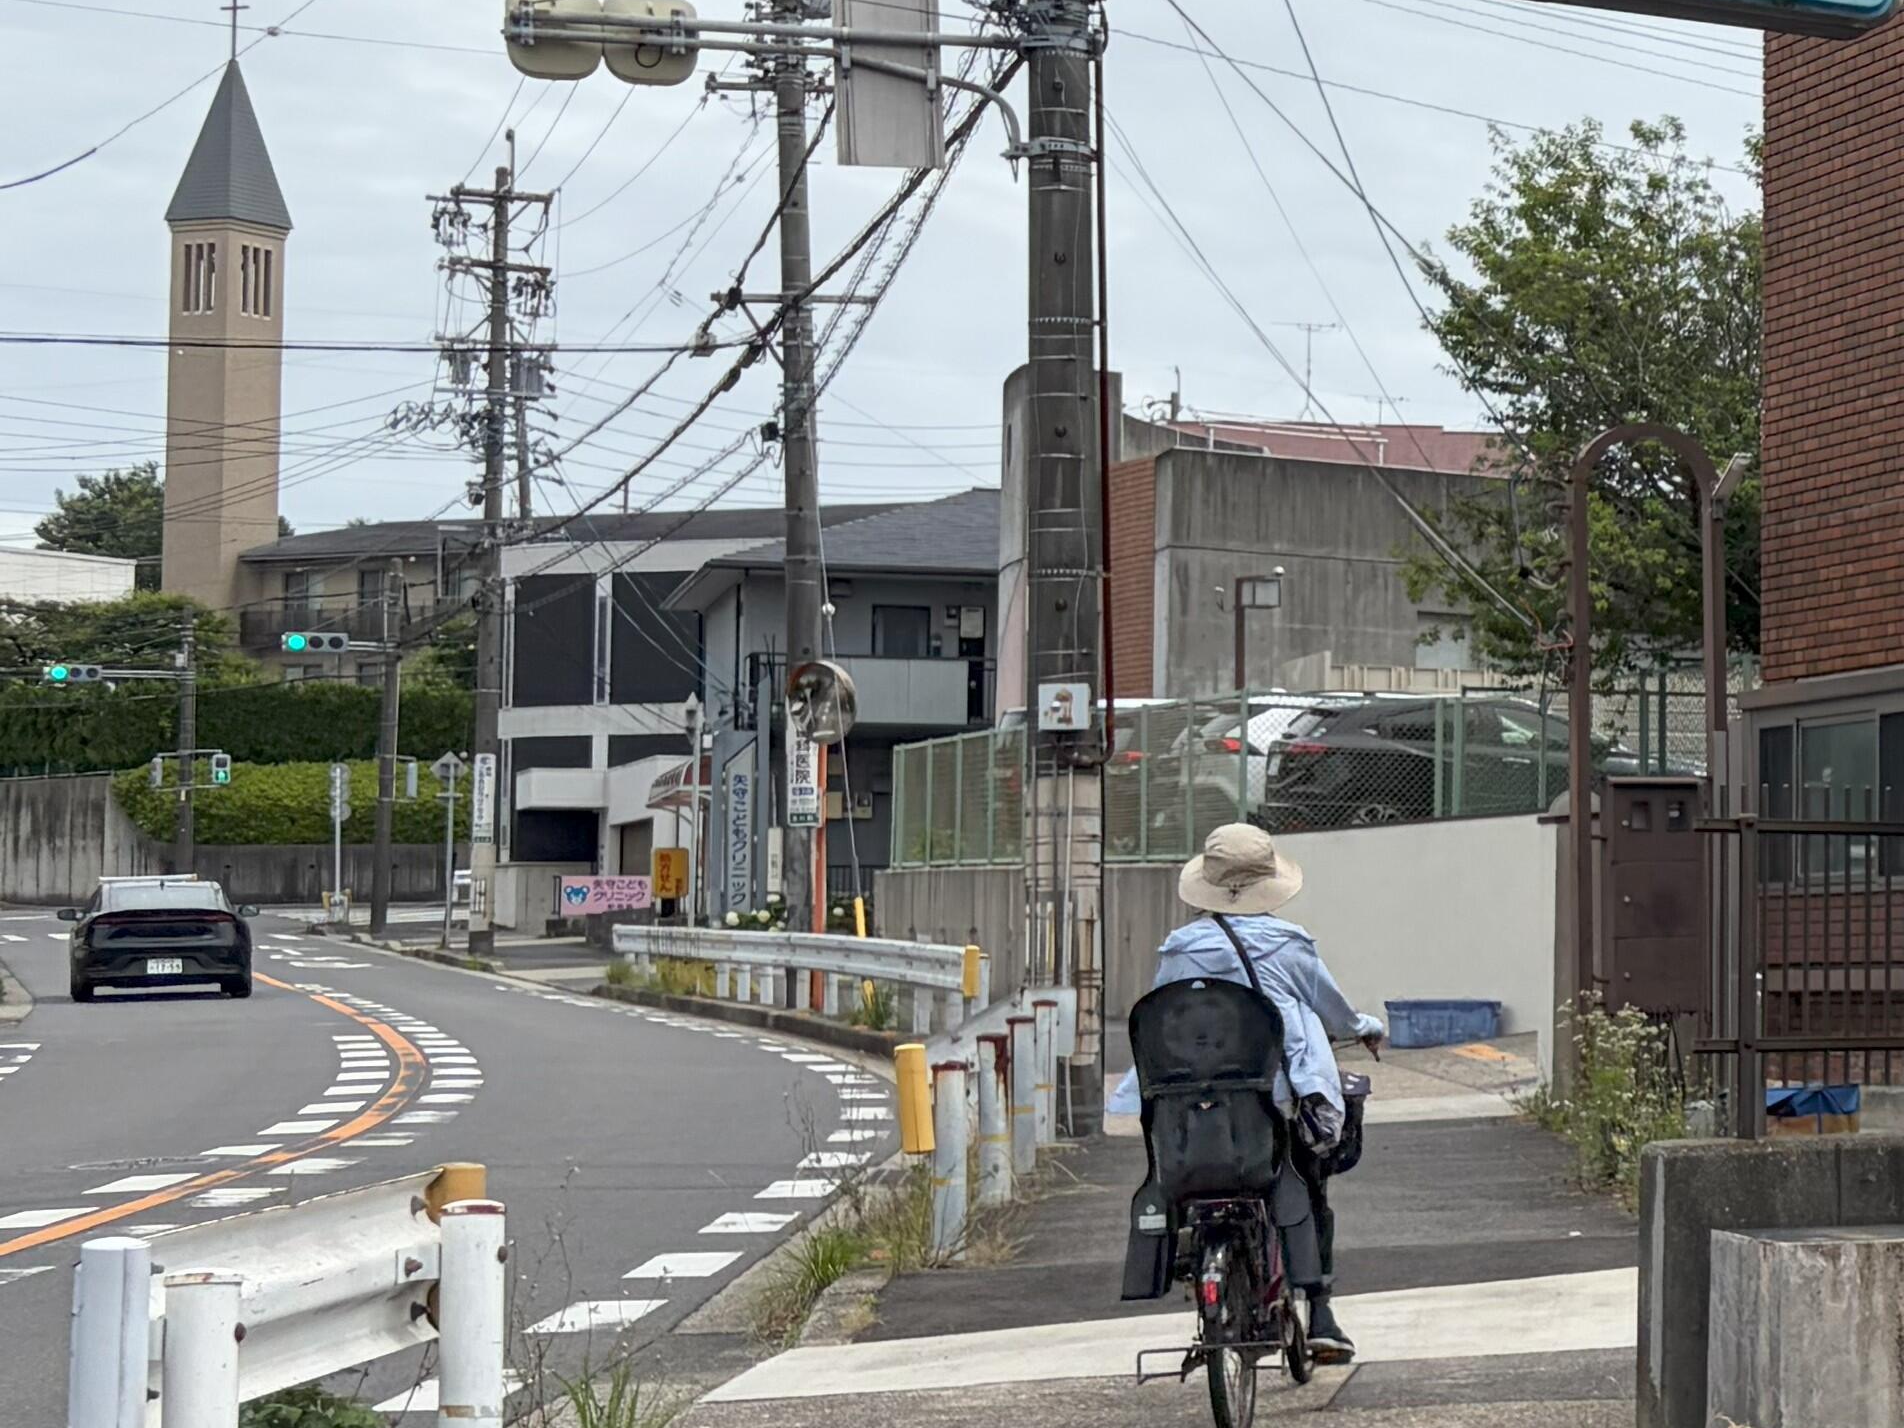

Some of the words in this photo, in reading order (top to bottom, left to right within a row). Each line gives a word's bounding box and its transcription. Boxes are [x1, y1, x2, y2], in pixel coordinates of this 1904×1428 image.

[731, 773, 749, 907] 矢守こどもクリニック
[593, 879, 647, 891] 矢守こども
[593, 891, 646, 902] クリニック
